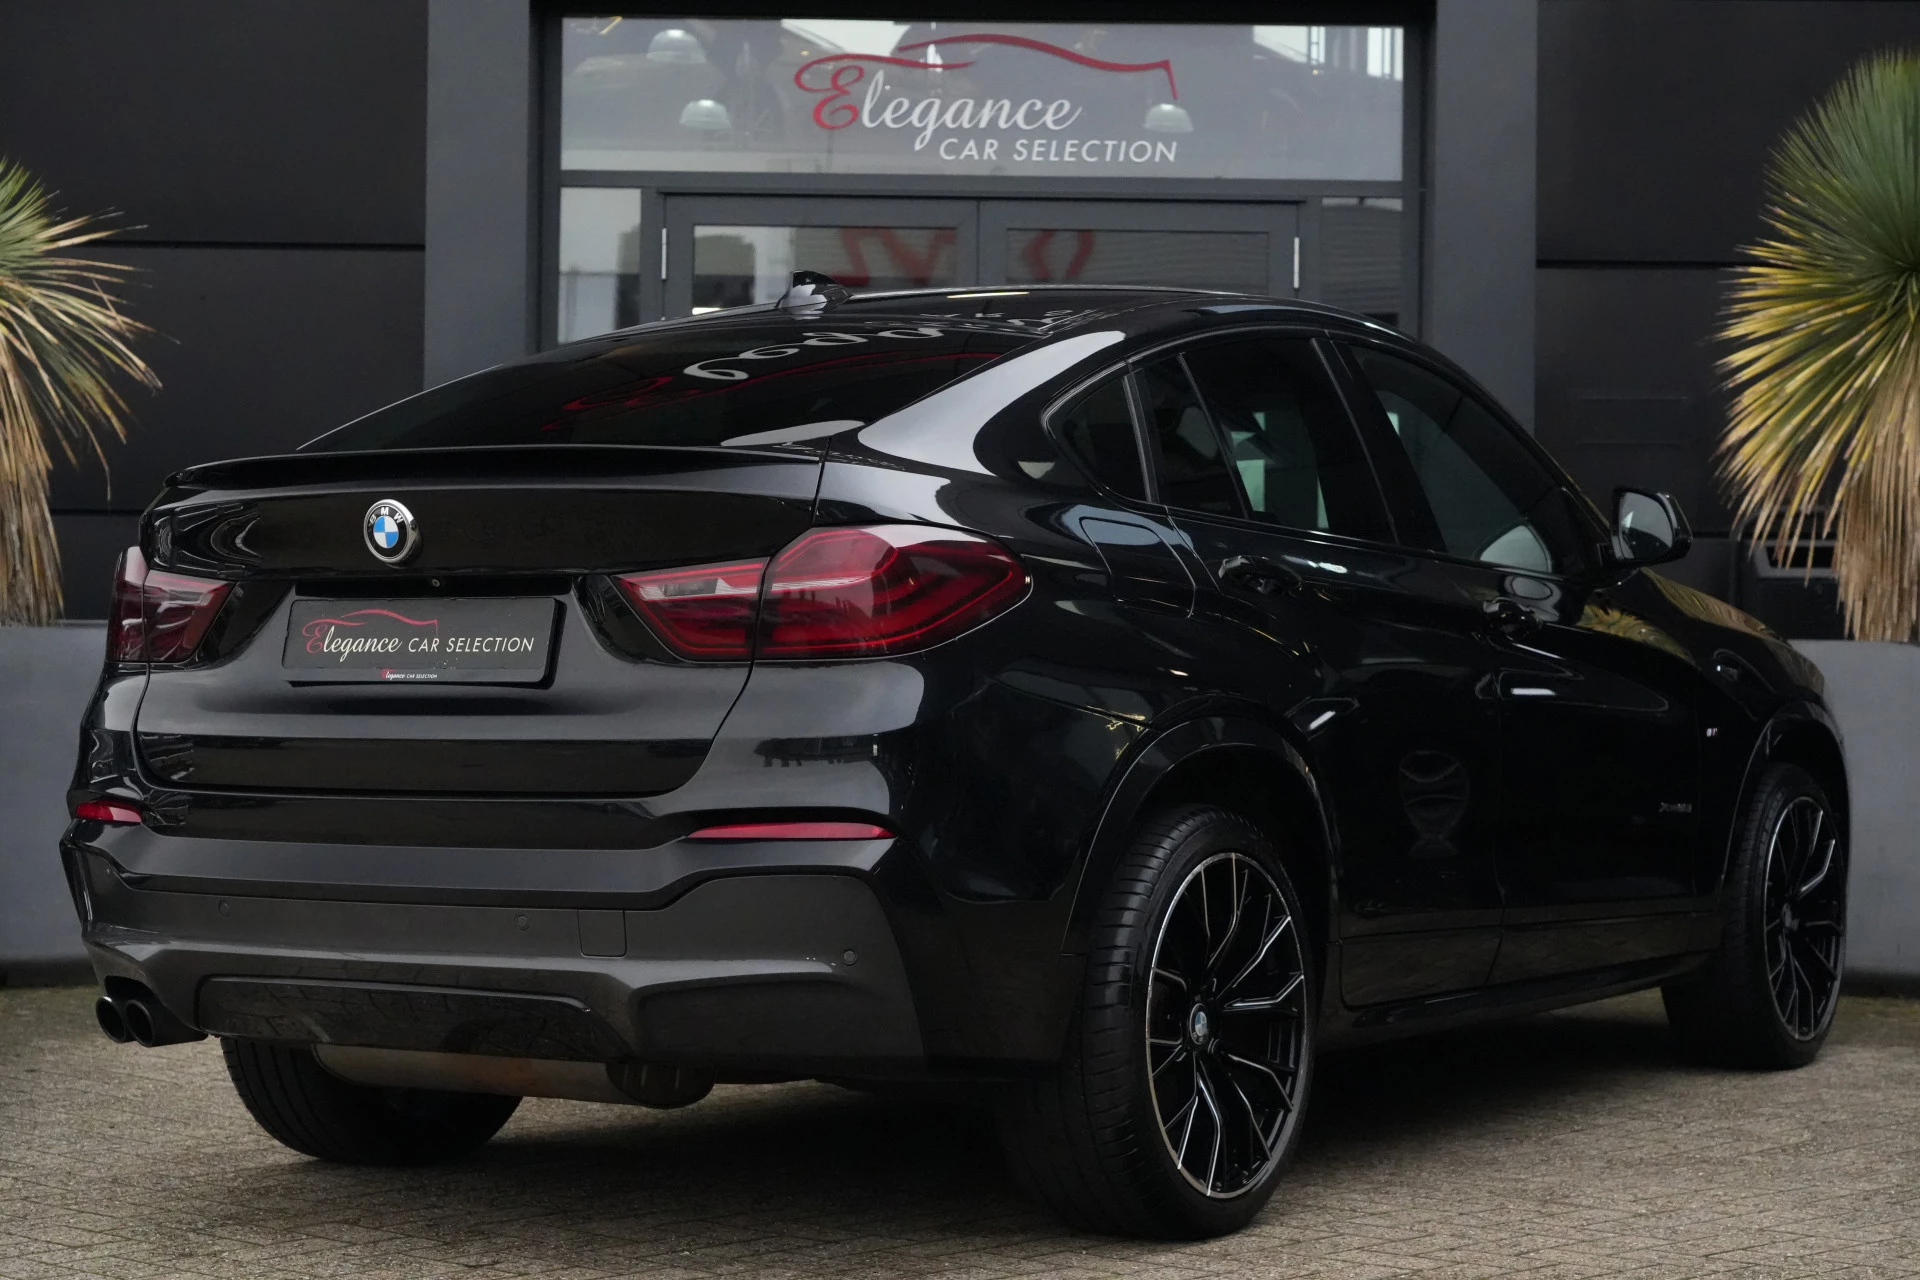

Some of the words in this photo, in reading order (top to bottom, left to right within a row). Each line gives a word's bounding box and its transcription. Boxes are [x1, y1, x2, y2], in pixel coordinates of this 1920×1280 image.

[795, 57, 1082, 152] Elegance
[938, 137, 1000, 161] CAR
[1013, 138, 1178, 163] SELECTION
[369, 506, 404, 525] BMW
[302, 620, 403, 663] Elegance
[408, 637, 440, 653] CAR
[446, 637, 535, 653] SELECTION
